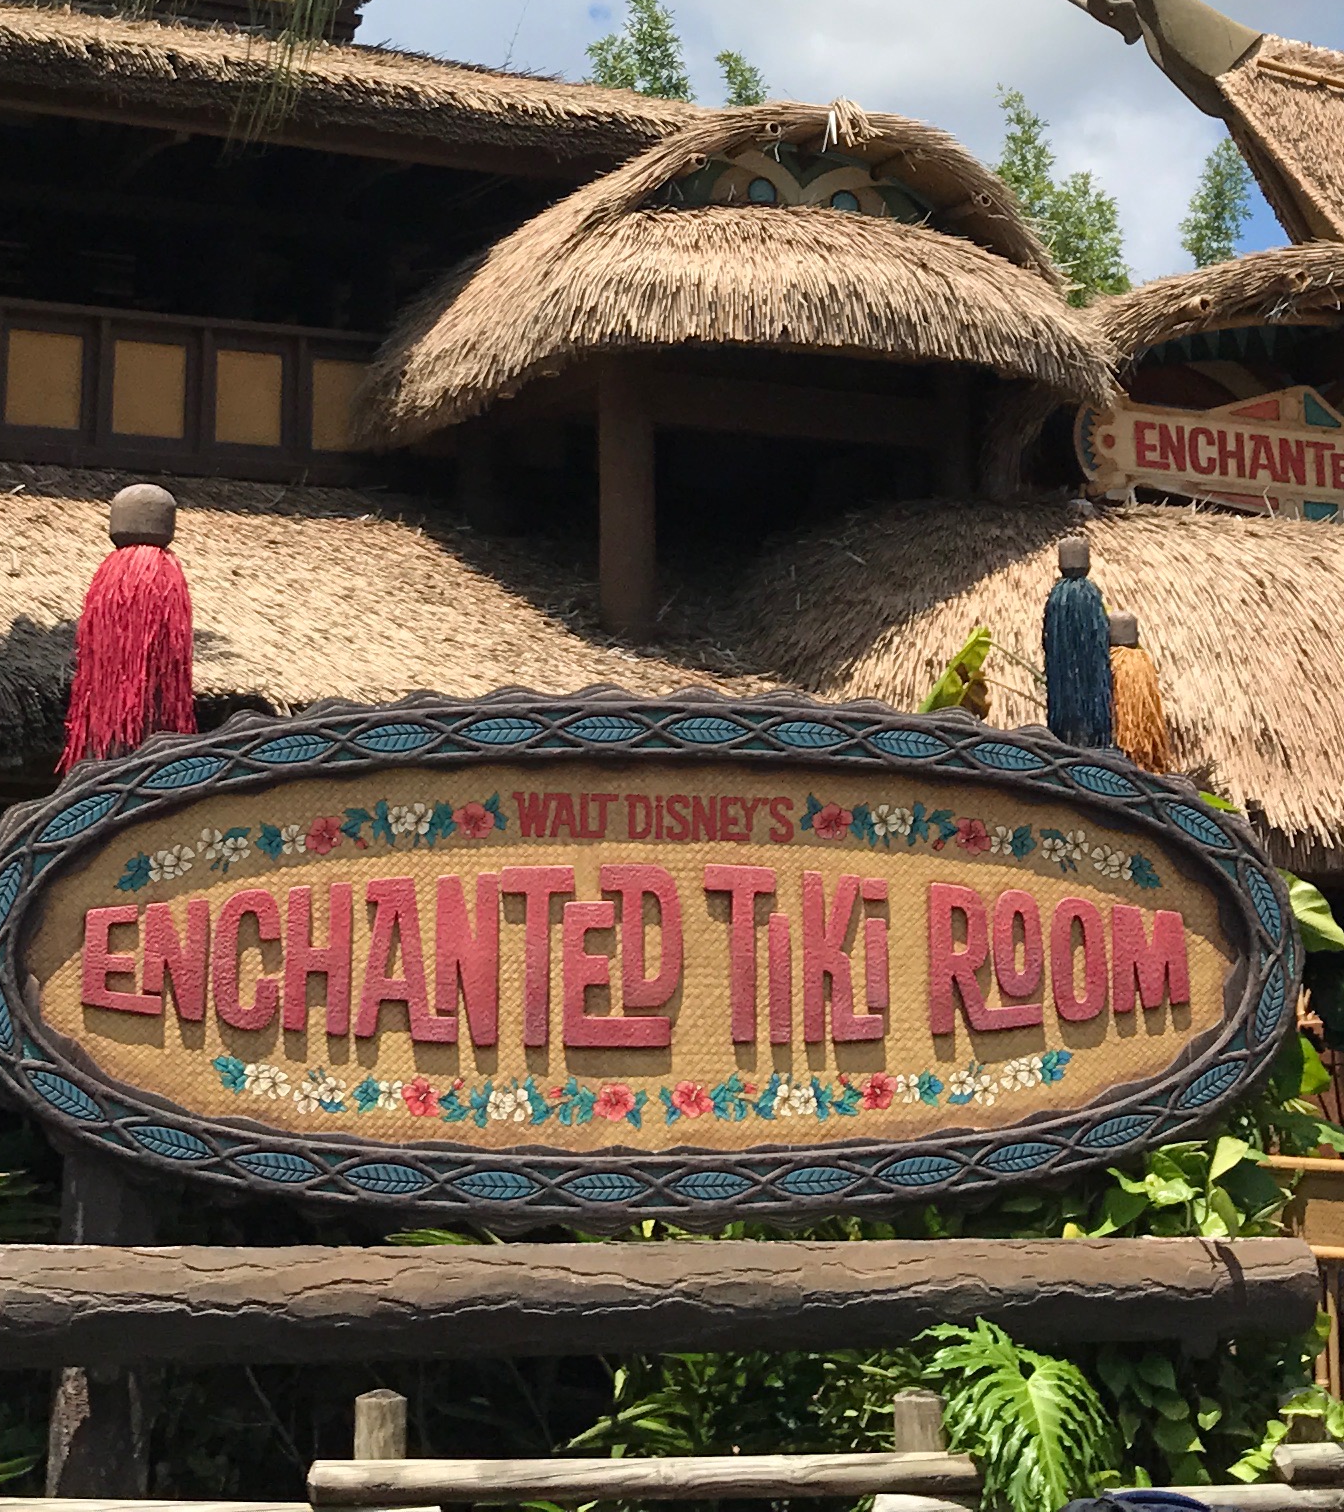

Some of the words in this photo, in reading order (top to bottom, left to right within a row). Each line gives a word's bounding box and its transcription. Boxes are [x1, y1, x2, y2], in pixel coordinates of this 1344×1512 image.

[512, 791, 619, 838] WALT
[625, 793, 794, 843] DISNEY'S
[81, 864, 684, 1048] ENCHANTED
[704, 864, 889, 1044] TIKI
[927, 881, 1192, 1036] ROOM
